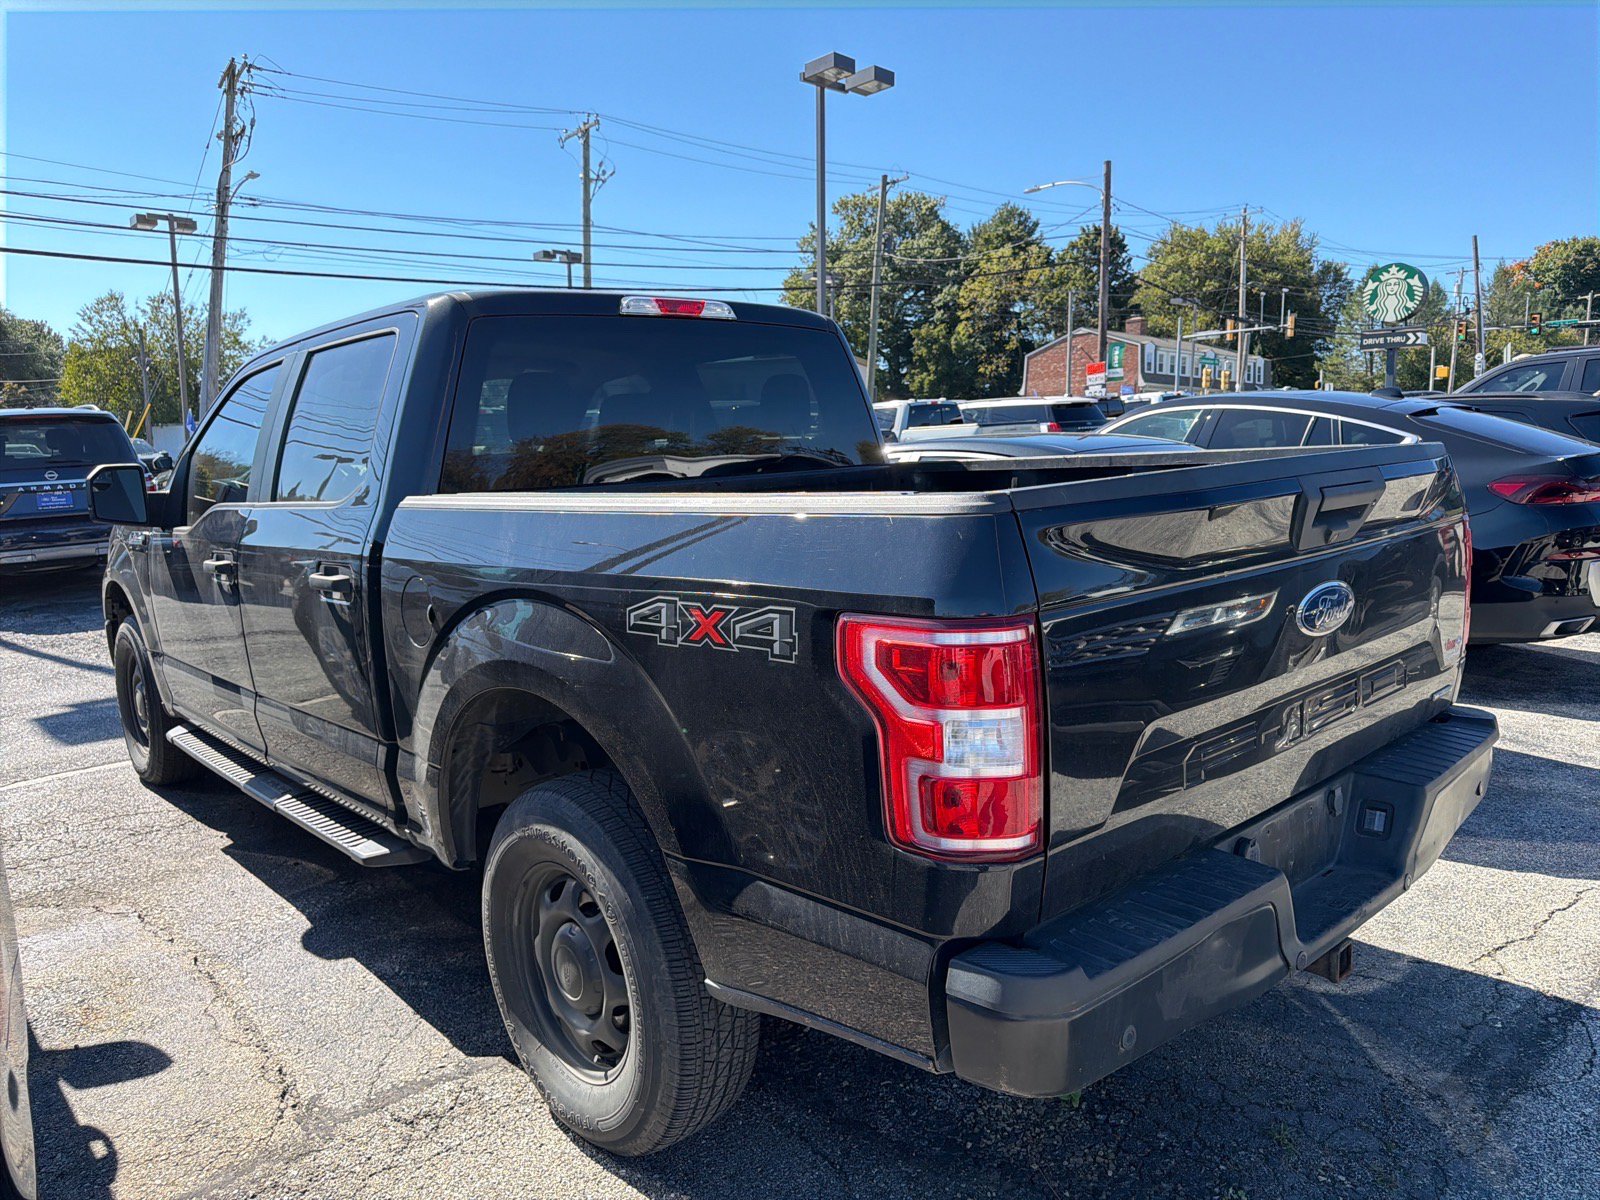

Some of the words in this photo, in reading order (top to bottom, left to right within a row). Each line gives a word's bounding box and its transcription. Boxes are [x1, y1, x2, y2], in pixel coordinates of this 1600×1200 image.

[1363, 337, 1384, 345] DRIVE
[1183, 658, 1407, 790] F-150
[521, 826, 597, 888] Firestone
